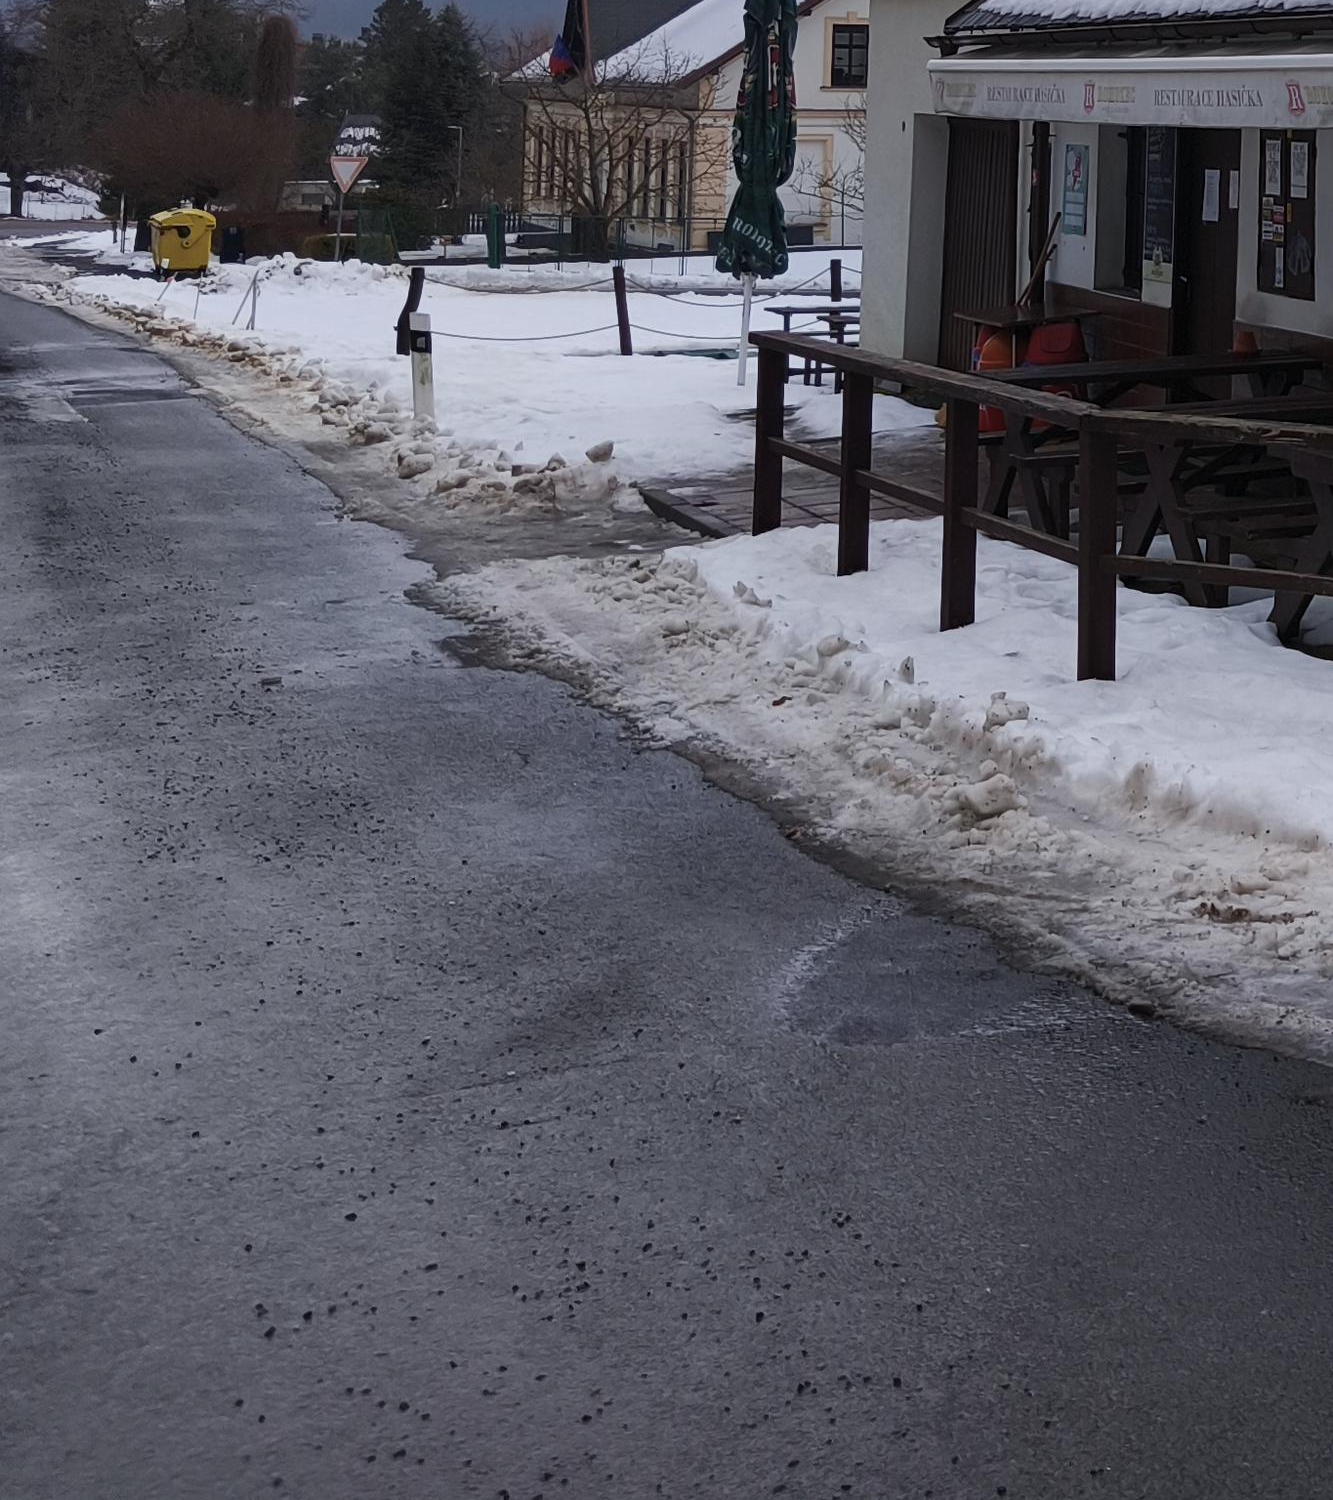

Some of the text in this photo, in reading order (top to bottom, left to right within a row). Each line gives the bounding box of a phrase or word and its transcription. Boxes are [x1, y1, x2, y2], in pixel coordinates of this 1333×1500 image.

[1153, 89, 1214, 107] RESTAURACE
[1216, 84, 1264, 107] HASIČKA
[1288, 85, 1304, 109] R
